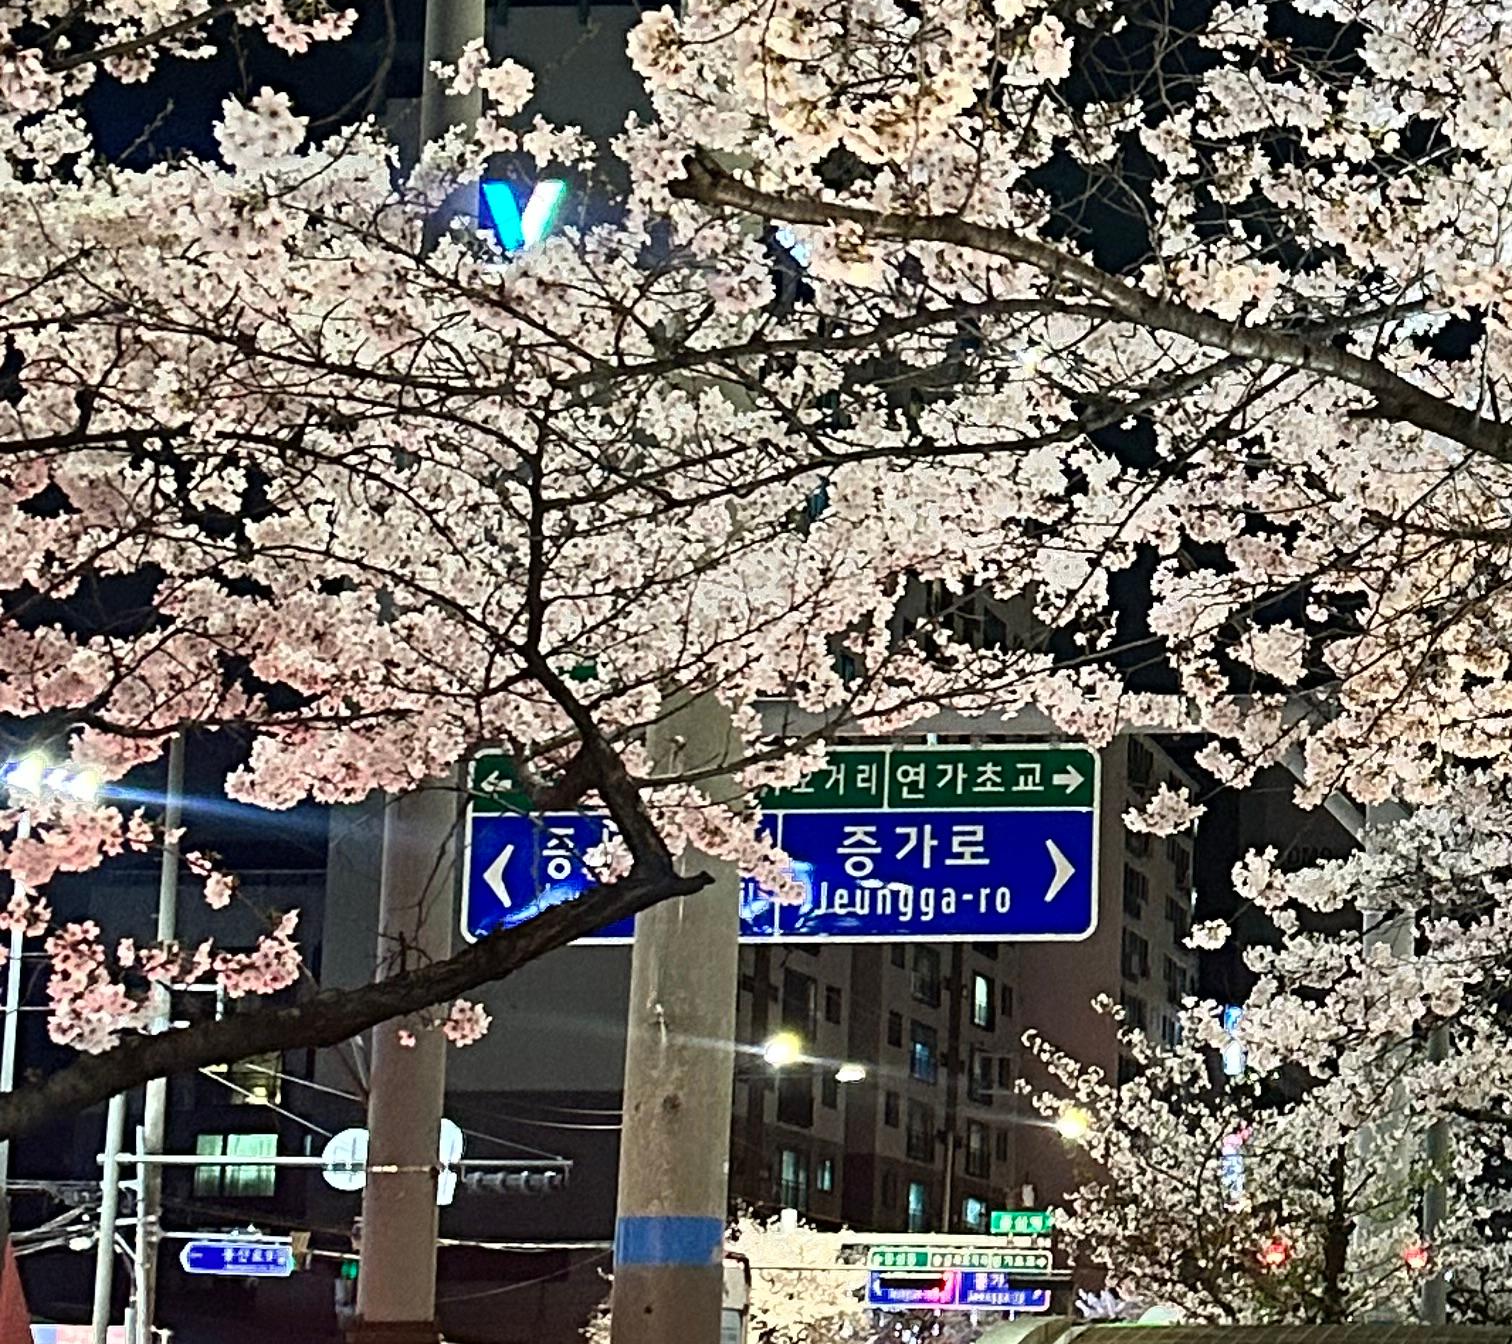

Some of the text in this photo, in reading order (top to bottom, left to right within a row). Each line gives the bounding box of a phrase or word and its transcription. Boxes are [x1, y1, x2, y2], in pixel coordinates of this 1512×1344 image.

[760, 763, 877, 797] 오거리
[896, 763, 1045, 799] 연가초교
[836, 824, 990, 877] 증가로
[813, 881, 1011, 921] Jeungga-ro
